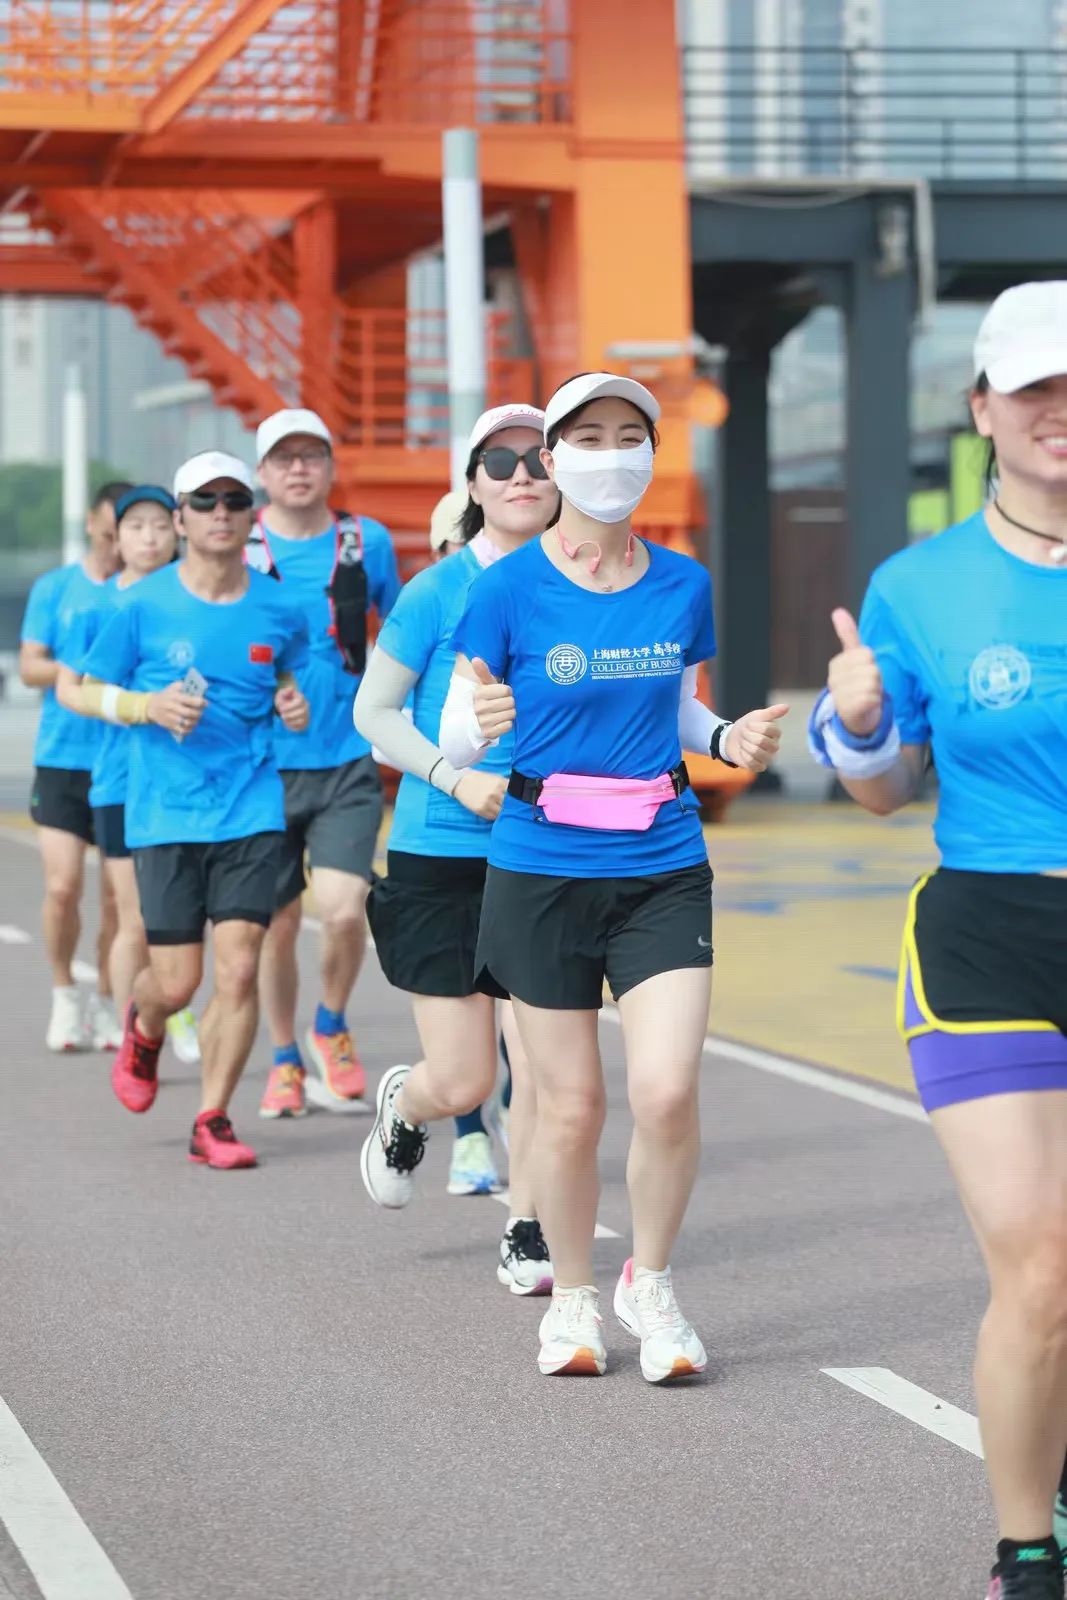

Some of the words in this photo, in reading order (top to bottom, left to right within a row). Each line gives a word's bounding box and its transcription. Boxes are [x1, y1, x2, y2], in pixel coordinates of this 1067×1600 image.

[594, 648, 650, 659] 上海财经大学
[591, 662, 635, 673] COLLEGE
[636, 661, 649, 671] OF
